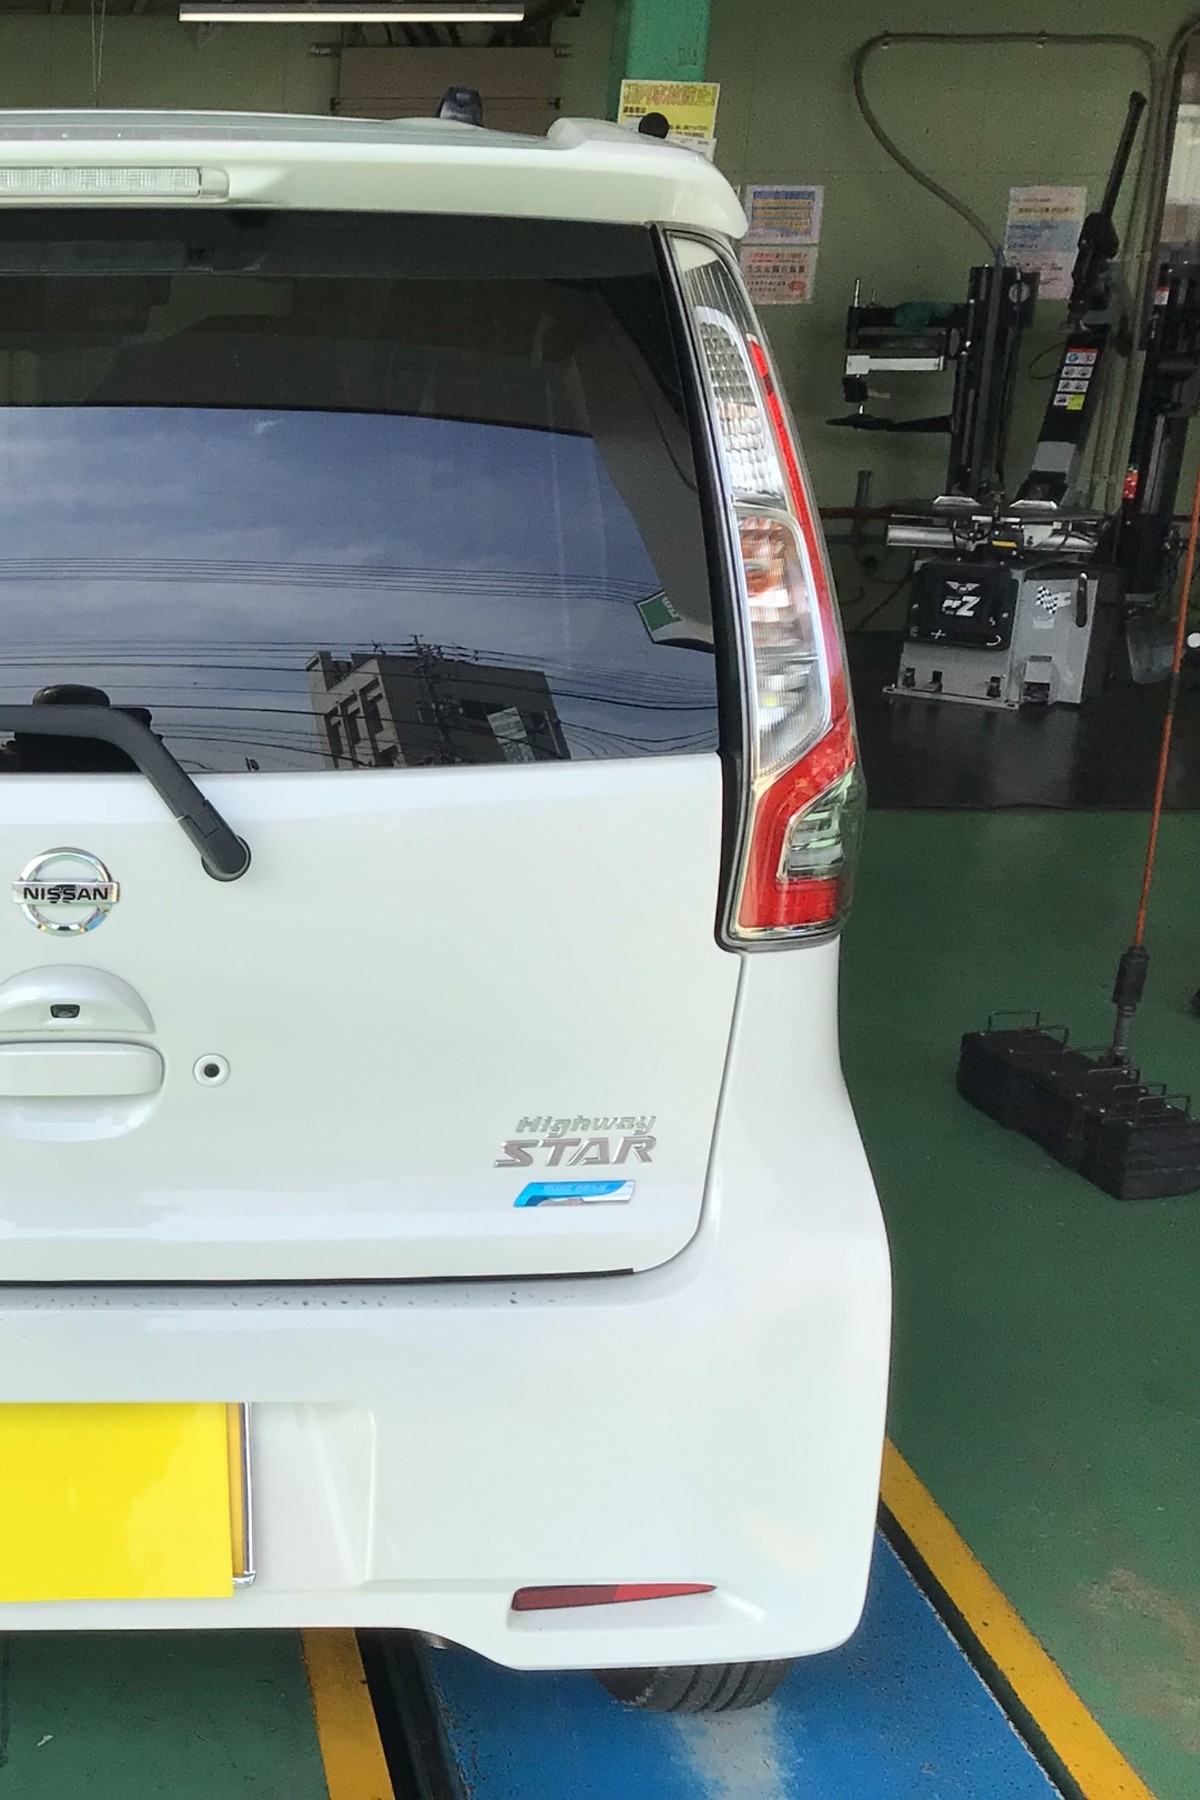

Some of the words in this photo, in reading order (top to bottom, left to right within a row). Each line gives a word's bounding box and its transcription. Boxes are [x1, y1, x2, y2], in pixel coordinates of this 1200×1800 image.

[23, 887, 108, 901] NISSAN
[515, 1114, 657, 1139] Highway
[492, 1135, 657, 1168] STAR
